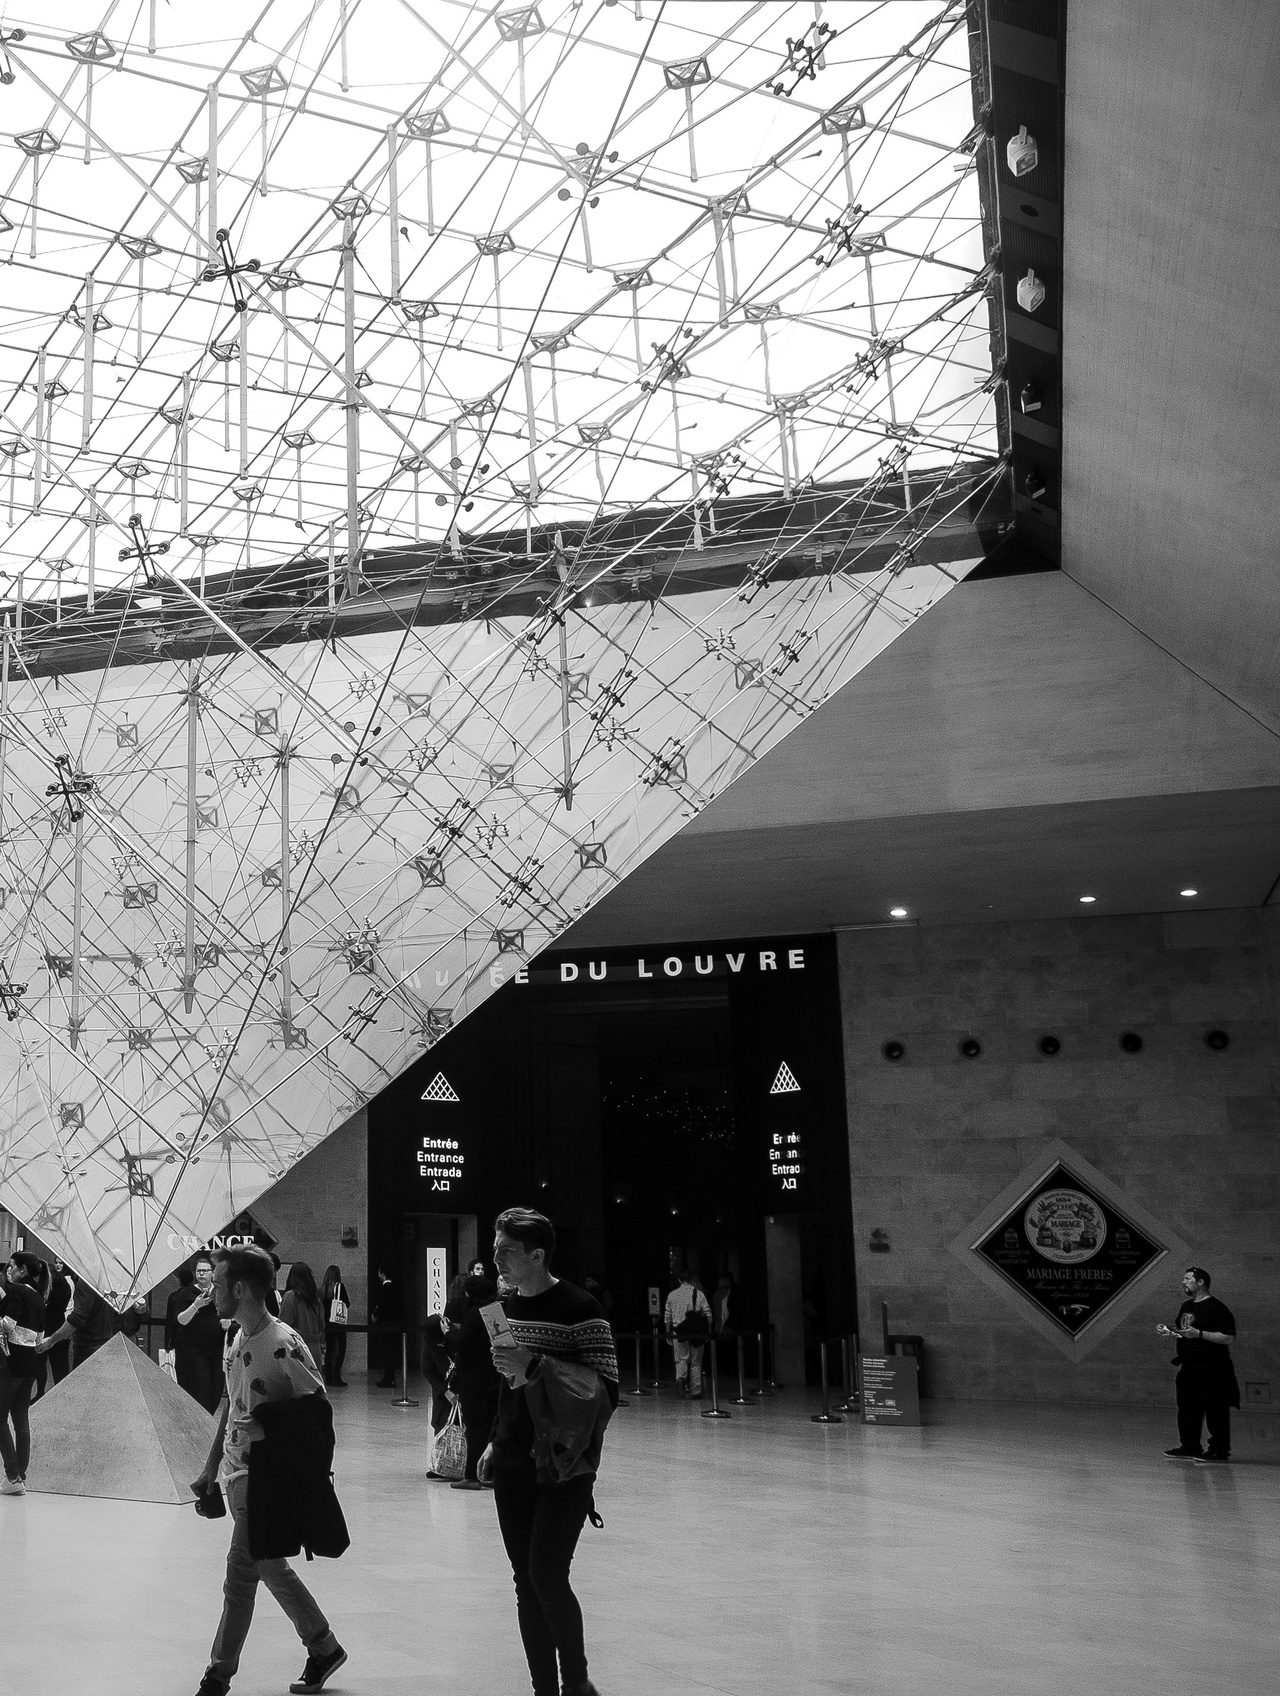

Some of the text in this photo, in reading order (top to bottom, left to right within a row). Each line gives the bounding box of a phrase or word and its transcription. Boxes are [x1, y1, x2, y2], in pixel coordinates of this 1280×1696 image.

[560, 961, 606, 982] DU
[638, 949, 806, 978] LOUVRE
[423, 1137, 459, 1149] Entrée
[416, 1150, 465, 1163] Entrance
[420, 1165, 462, 1178] Entrada
[431, 1179, 450, 1191] 入口
[781, 1178, 797, 1190] 入口
[1050, 1220, 1082, 1228] MARIAGE
[1026, 1268, 1072, 1279] MARIAGE
